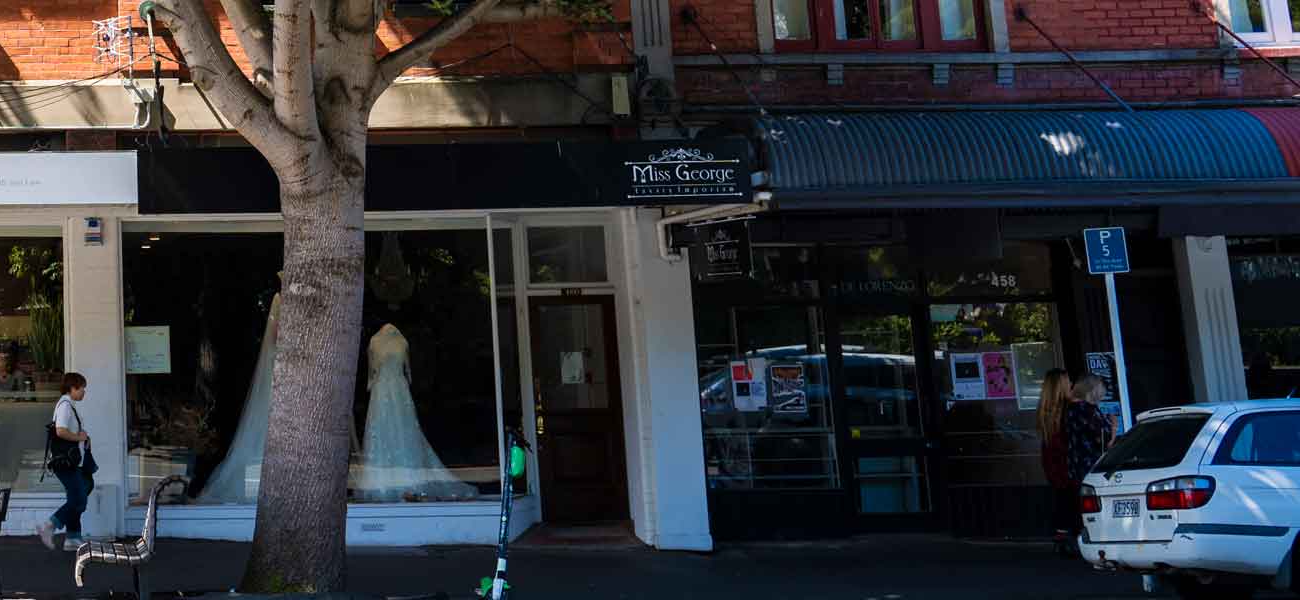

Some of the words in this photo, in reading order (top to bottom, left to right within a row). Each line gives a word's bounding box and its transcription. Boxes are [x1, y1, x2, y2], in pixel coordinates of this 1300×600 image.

[632, 164, 671, 183] Miss
[675, 163, 735, 183] George
[1099, 230, 1111, 245] P
[1101, 244, 1110, 257] 5
[991, 275, 1017, 288] 458
